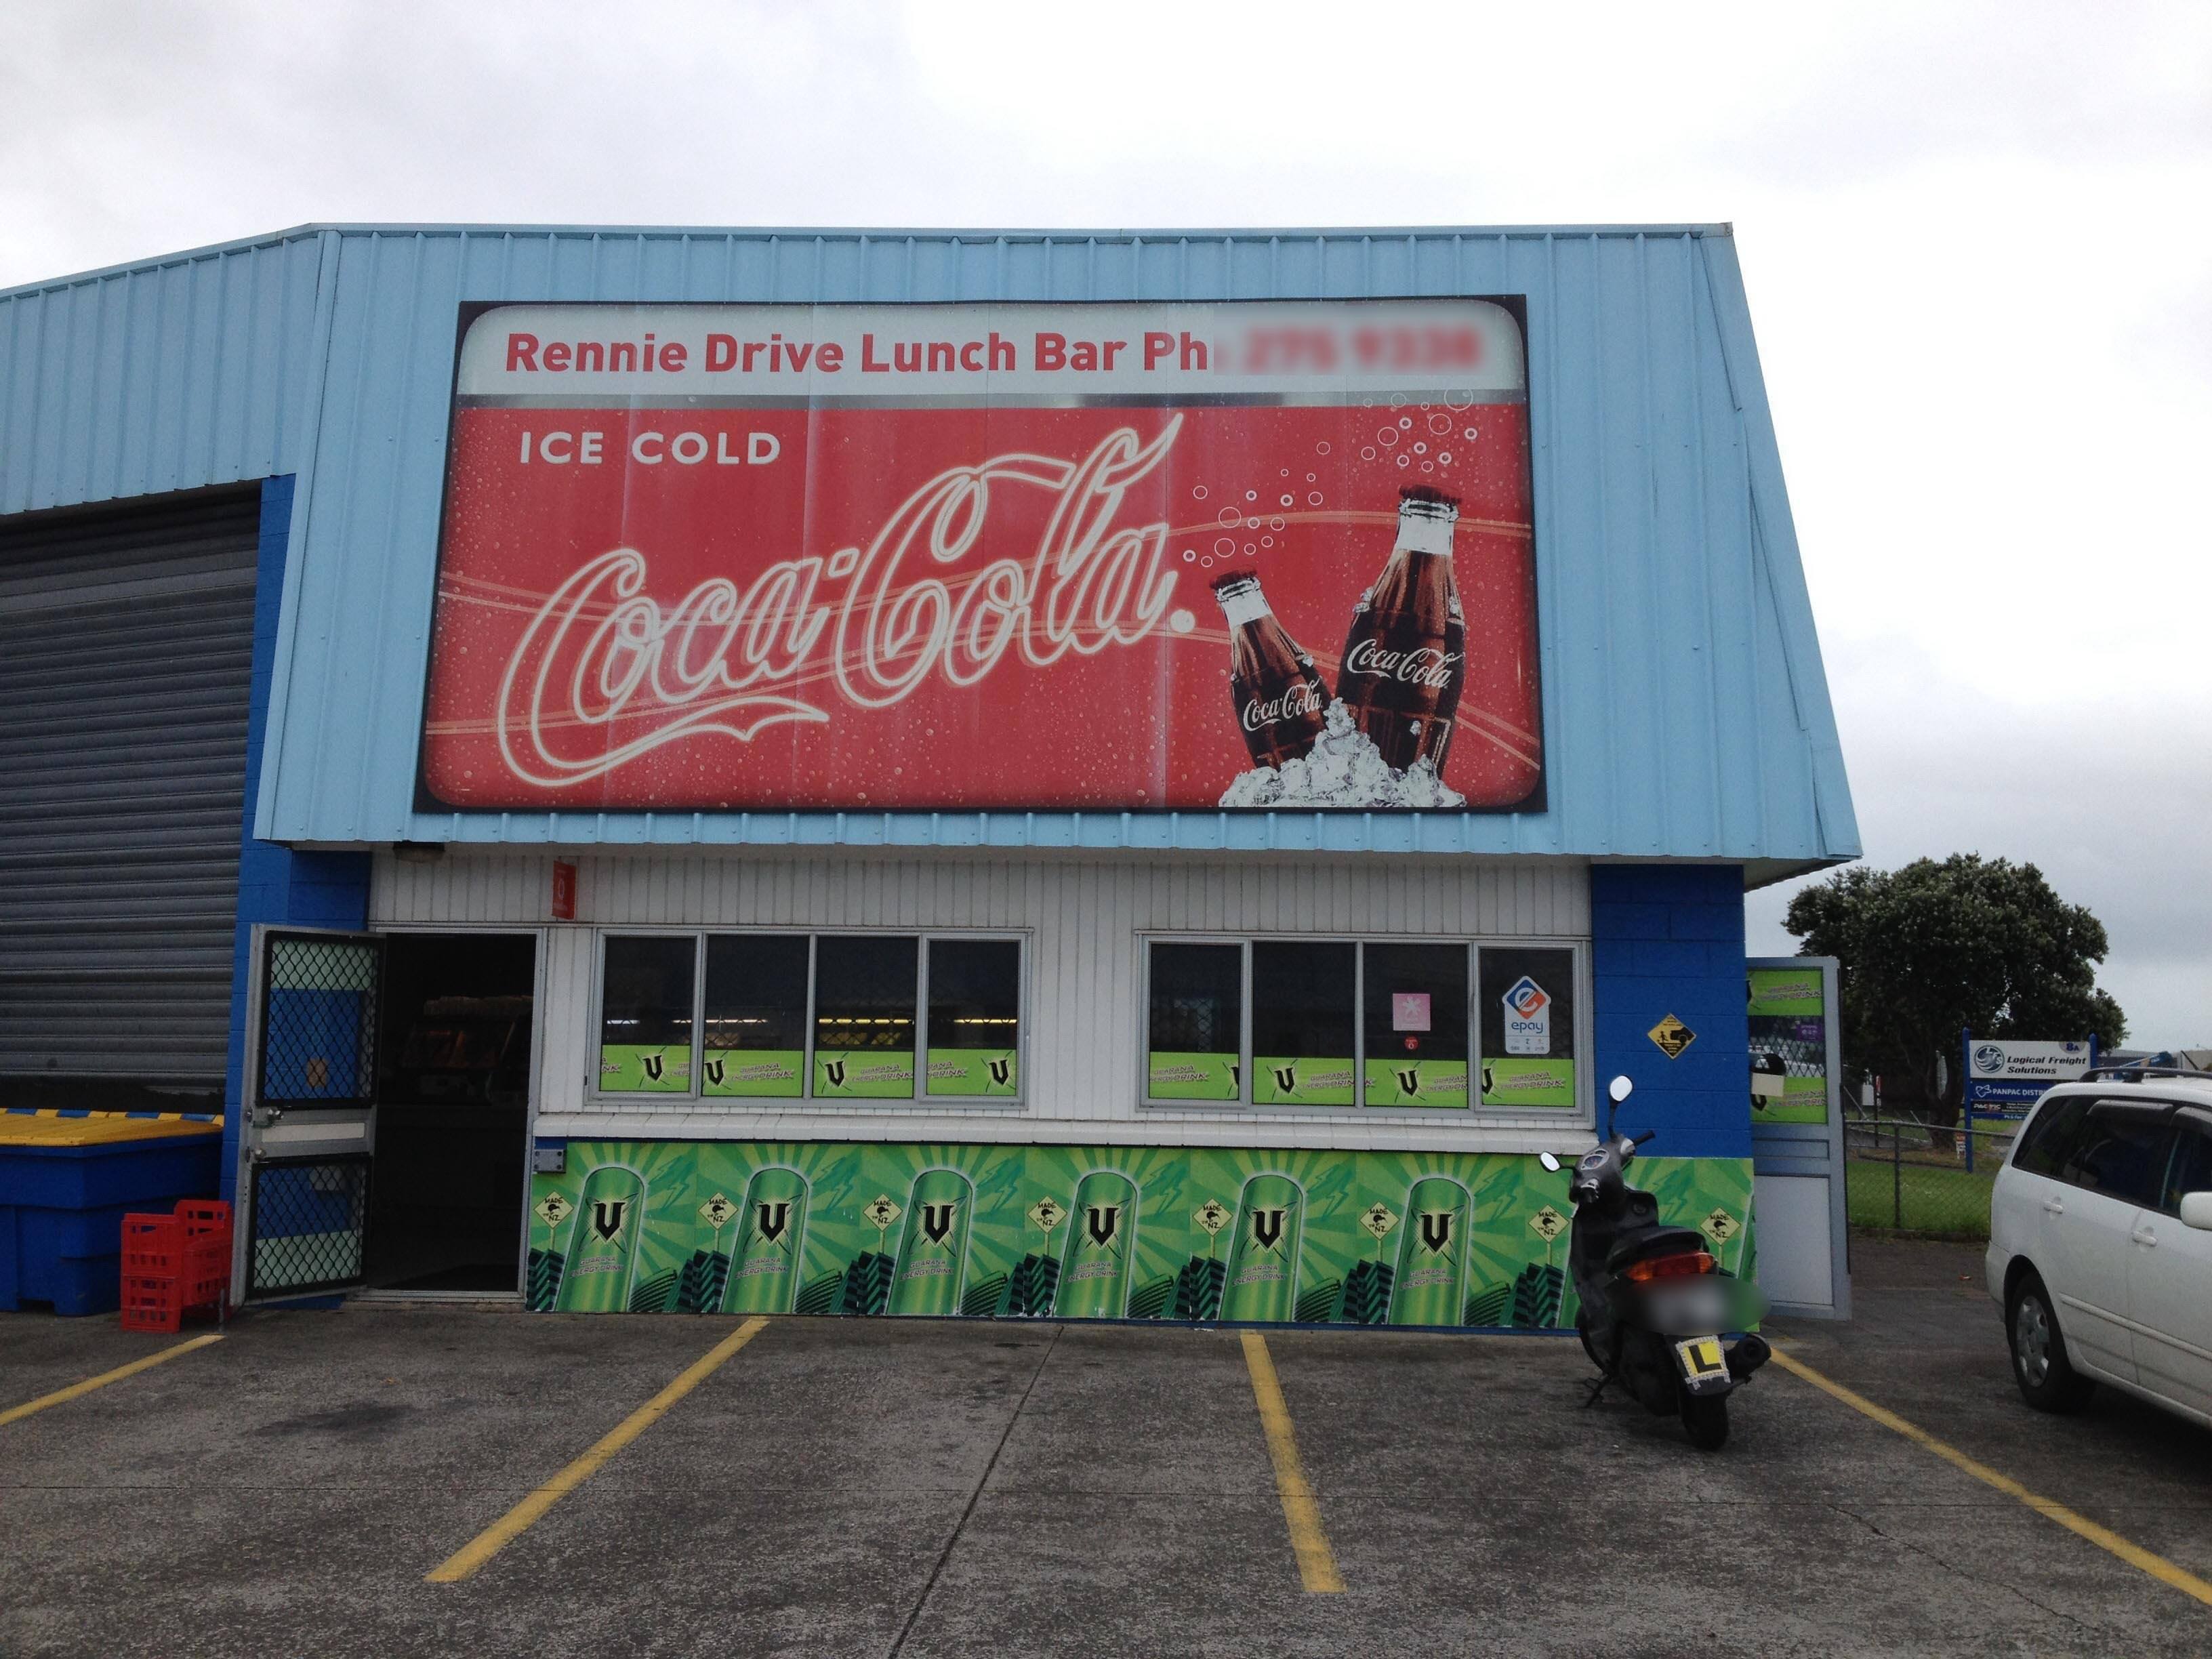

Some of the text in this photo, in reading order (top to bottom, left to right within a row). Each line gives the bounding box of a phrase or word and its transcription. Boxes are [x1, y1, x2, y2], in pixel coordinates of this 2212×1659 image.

[506, 332, 687, 373] Rennie
[705, 332, 844, 373] Drive
[861, 332, 1016, 373] Lunch
[1034, 332, 1127, 372] Bar
[520, 431, 781, 465] ICE COLD
[1511, 1022, 1543, 1033] epay
[2007, 1056, 2087, 1065] Logical Freight
[2066, 1042, 2080, 1051] 8A
[2007, 1067, 2057, 1075] Solutions
[593, 1202, 626, 1242] V
[1038, 1201, 1056, 1209] MADE
[757, 1203, 790, 1243] V
[922, 1204, 955, 1246] V
[1042, 1219, 1055, 1227] NZ
[1087, 1207, 1120, 1248] V
[1252, 1210, 1286, 1250] V
[1420, 1214, 1454, 1254] V
[1688, 1344, 1723, 1374] L
